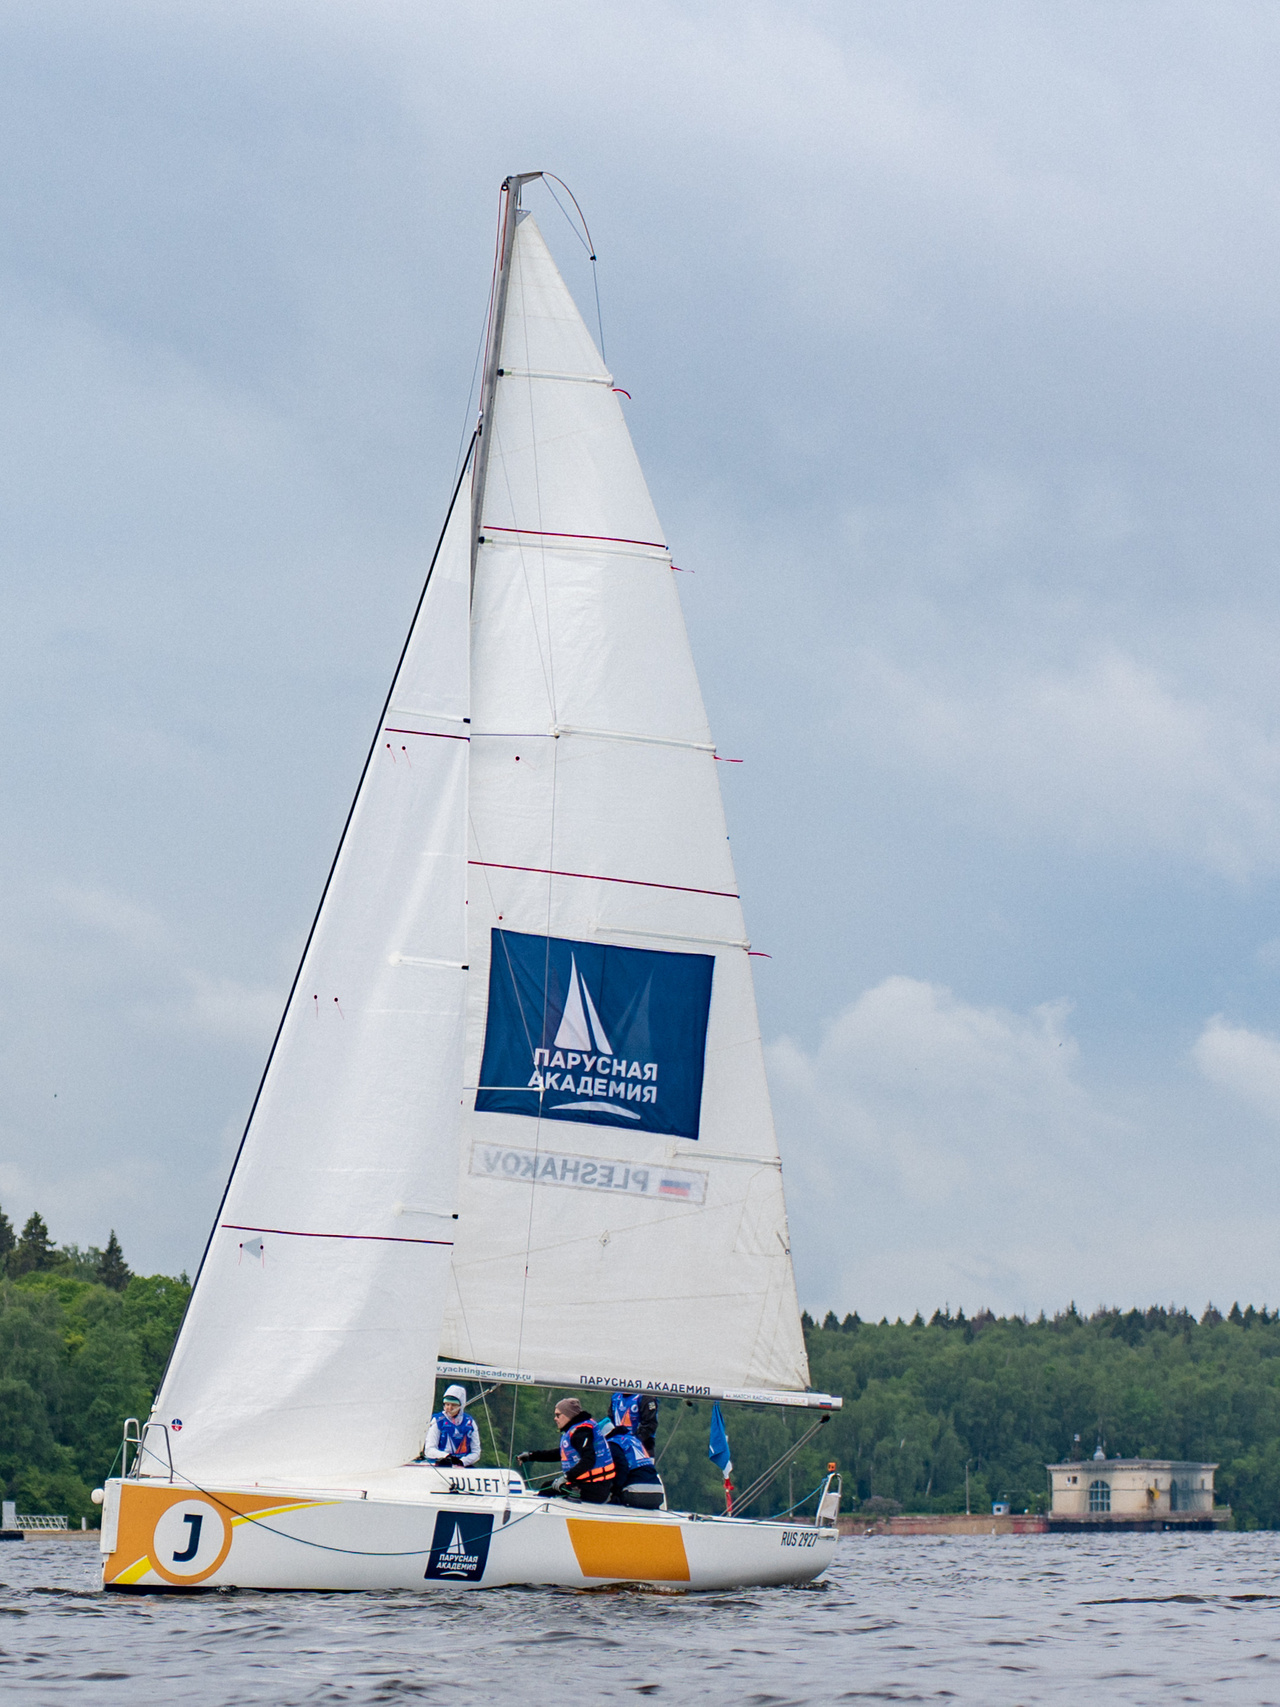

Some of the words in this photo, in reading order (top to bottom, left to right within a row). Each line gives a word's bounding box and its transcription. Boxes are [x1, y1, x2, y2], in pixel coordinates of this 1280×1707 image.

[533, 1048, 658, 1082] ПАРУСНАЯ
[527, 1070, 657, 1104] АКАДЕМИЯ
[580, 1375, 642, 1389] ПАРУСНАЯ
[646, 1381, 711, 1396] АКАДЕМИЯ
[448, 1476, 500, 1494] JULIET
[172, 1513, 204, 1563] J
[781, 1531, 798, 1547] RUS
[798, 1532, 819, 1548] 2927
[436, 1562, 477, 1571] АКАДЕМИЯ
[439, 1553, 478, 1563] ПАРУСНАЯ
